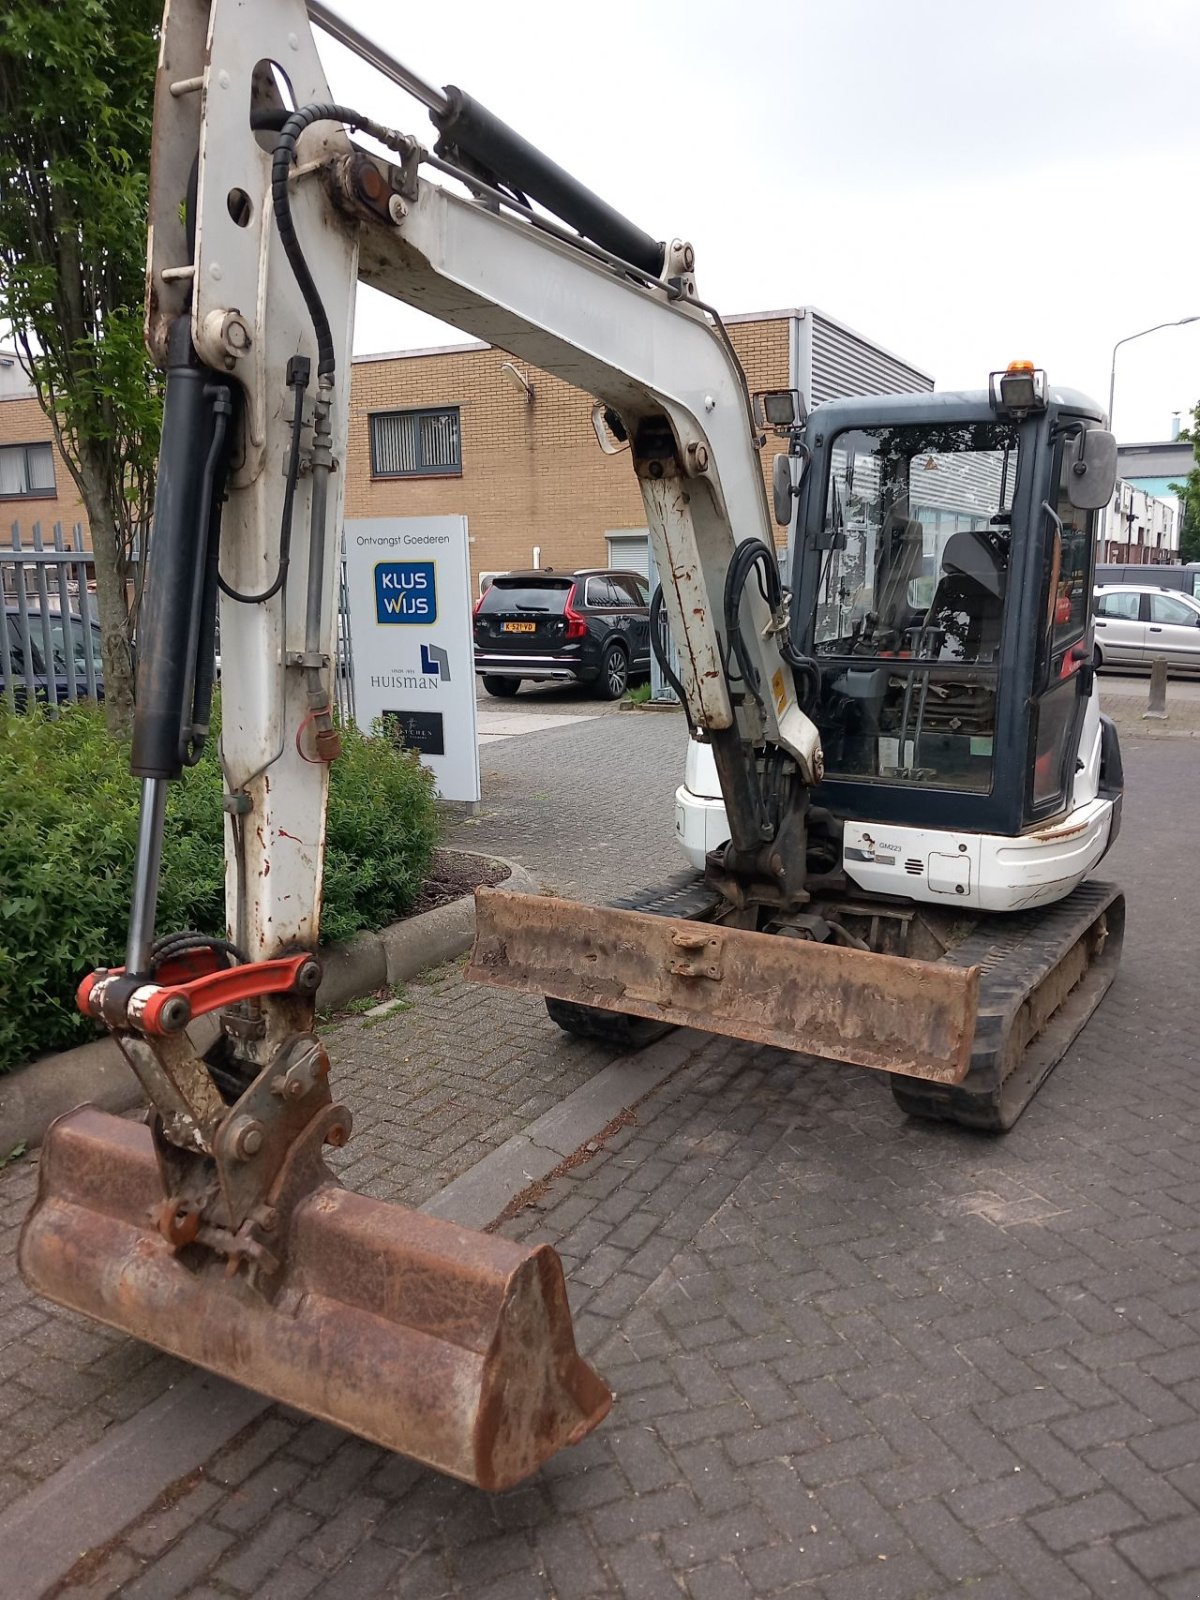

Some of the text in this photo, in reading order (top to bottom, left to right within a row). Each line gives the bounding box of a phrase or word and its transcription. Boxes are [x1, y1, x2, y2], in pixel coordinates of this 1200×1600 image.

[356, 535, 450, 547] Ontvangst Goederen
[382, 573, 427, 589] KLUS
[384, 591, 429, 614] WIJS
